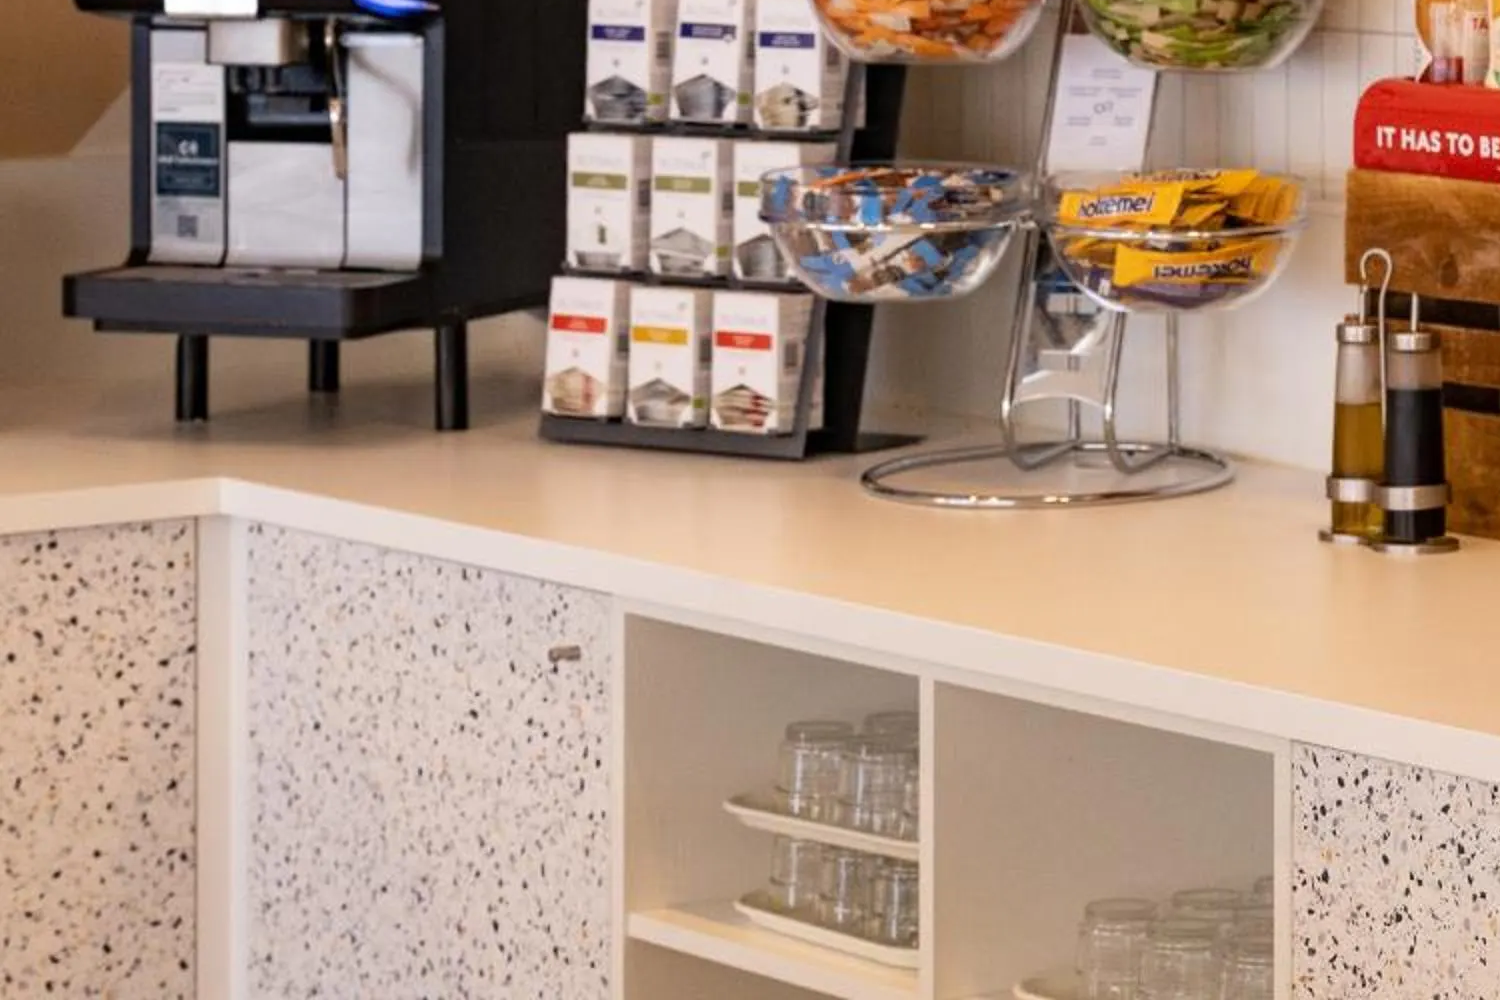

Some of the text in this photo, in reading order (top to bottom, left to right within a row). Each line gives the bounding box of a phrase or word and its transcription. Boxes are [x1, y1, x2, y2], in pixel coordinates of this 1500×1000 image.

[1376, 126, 1397, 149] IT
[1401, 128, 1441, 153] HAS
[1445, 131, 1475, 157] TO
